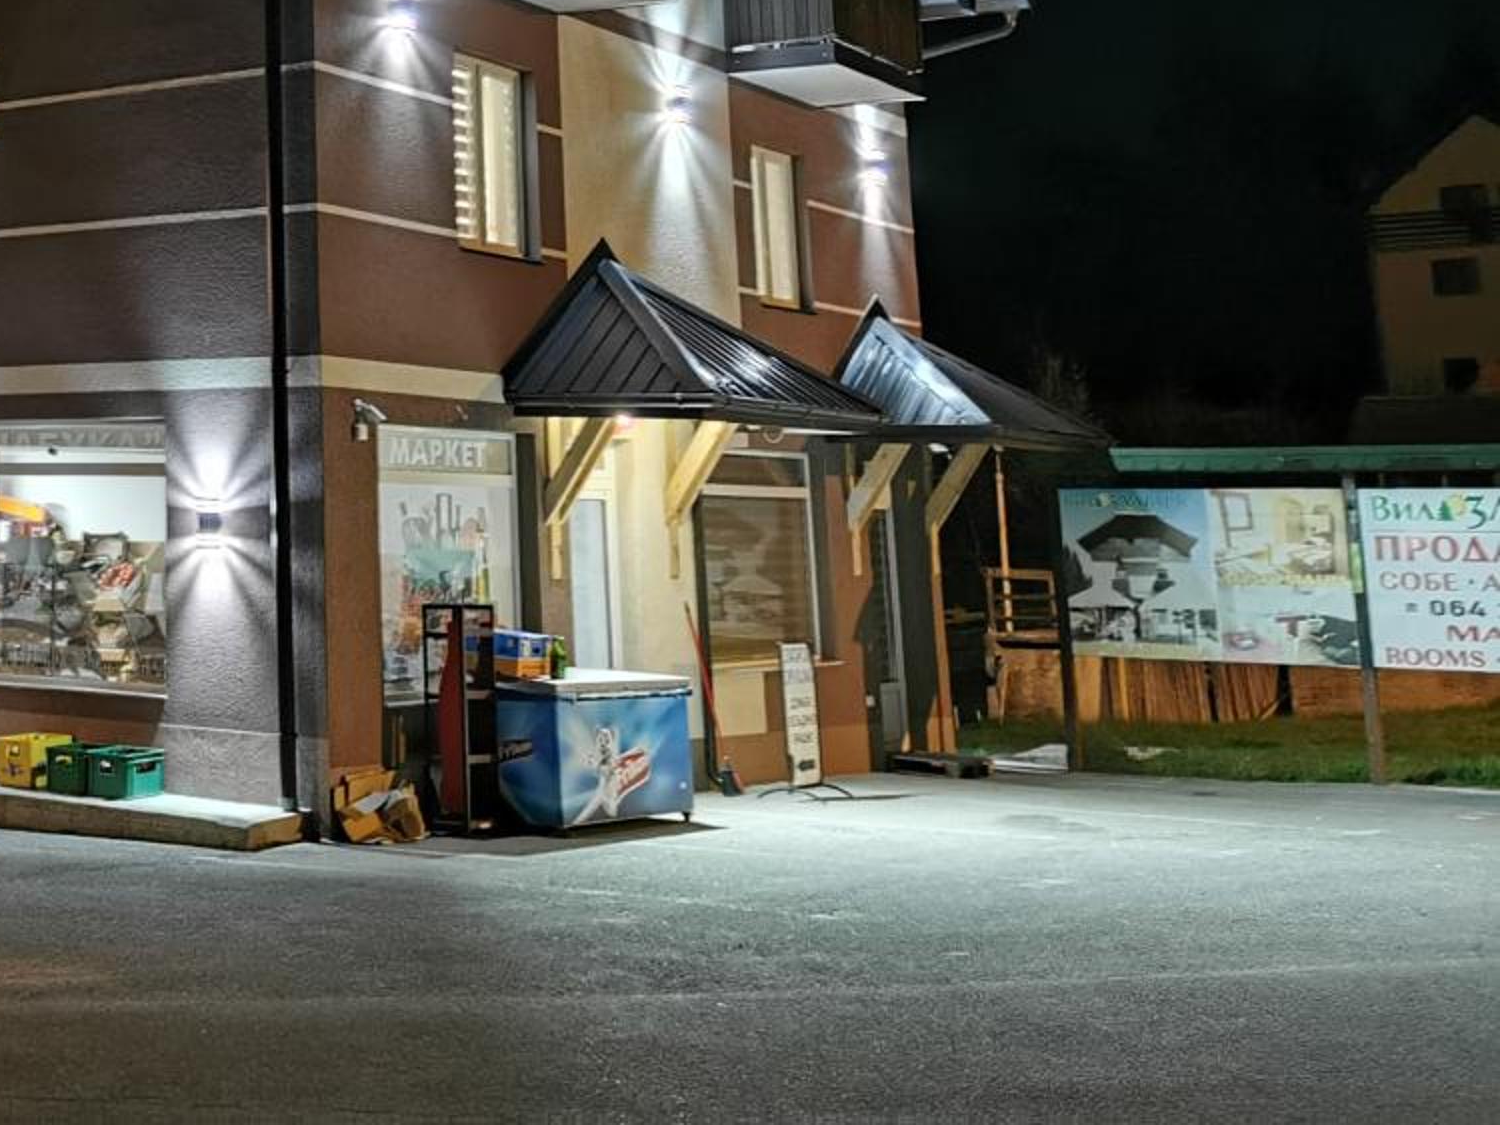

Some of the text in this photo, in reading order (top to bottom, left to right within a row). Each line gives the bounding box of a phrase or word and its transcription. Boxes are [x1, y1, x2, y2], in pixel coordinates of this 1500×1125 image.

[388, 436, 486, 468] МАРКЕТ
[1374, 535, 1500, 563] ПРОД
[1380, 571, 1460, 591] СОБЕ
[1428, 599, 1486, 617] 064
[1385, 646, 1486, 668] ROOMS
